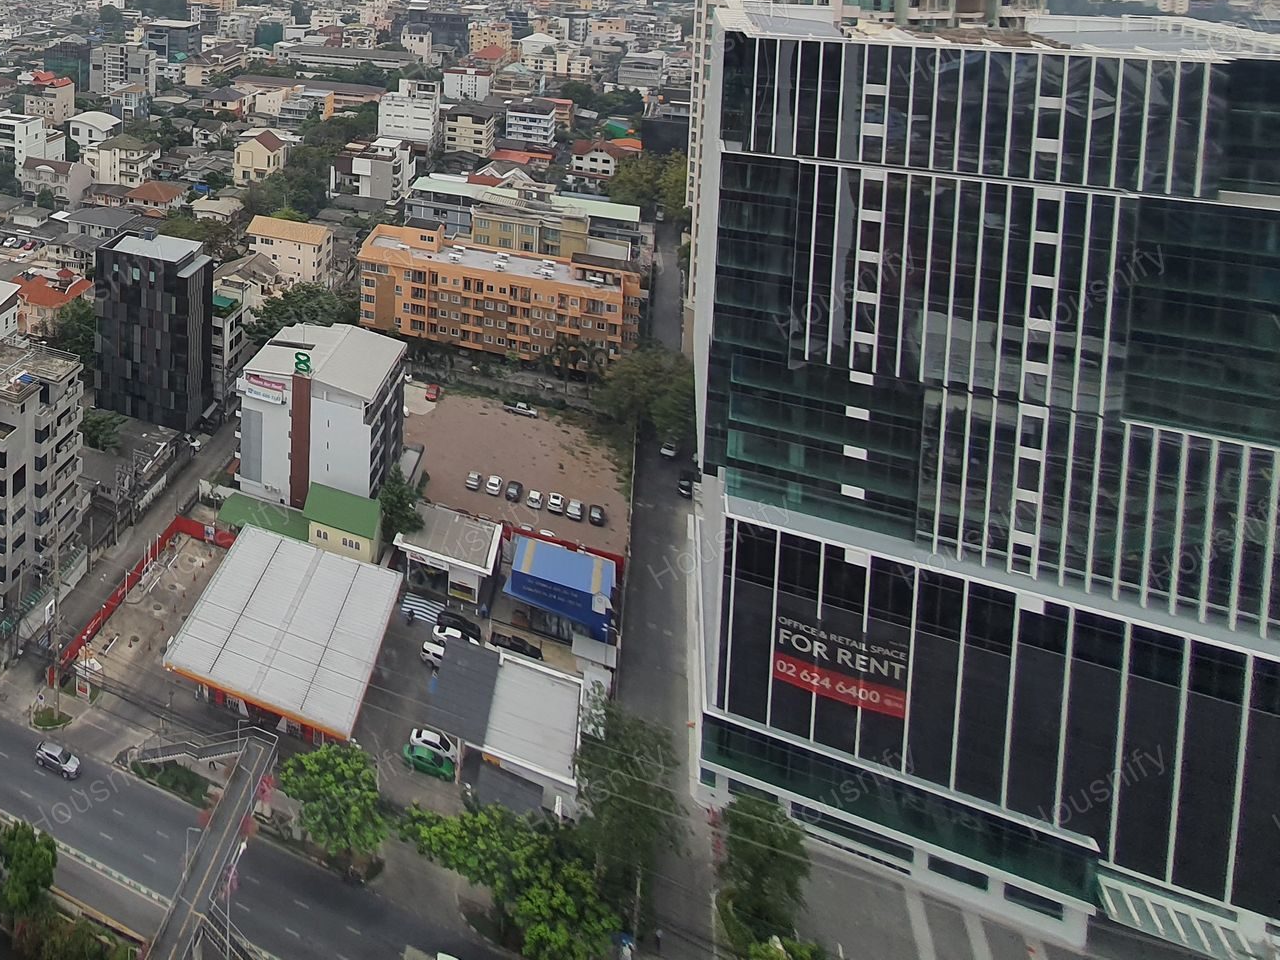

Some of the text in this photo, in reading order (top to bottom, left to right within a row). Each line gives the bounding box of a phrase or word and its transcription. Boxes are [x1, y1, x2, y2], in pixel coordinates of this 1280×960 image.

[778, 616, 818, 637] OFFICE
[818, 630, 828, 640] &
[830, 633, 868, 652] RETAIL
[870, 645, 907, 660] SPACE
[778, 628, 906, 680] FOR RENT
[776, 660, 796, 678] 02
[800, 669, 832, 689] 624
[835, 681, 881, 704] 6400
